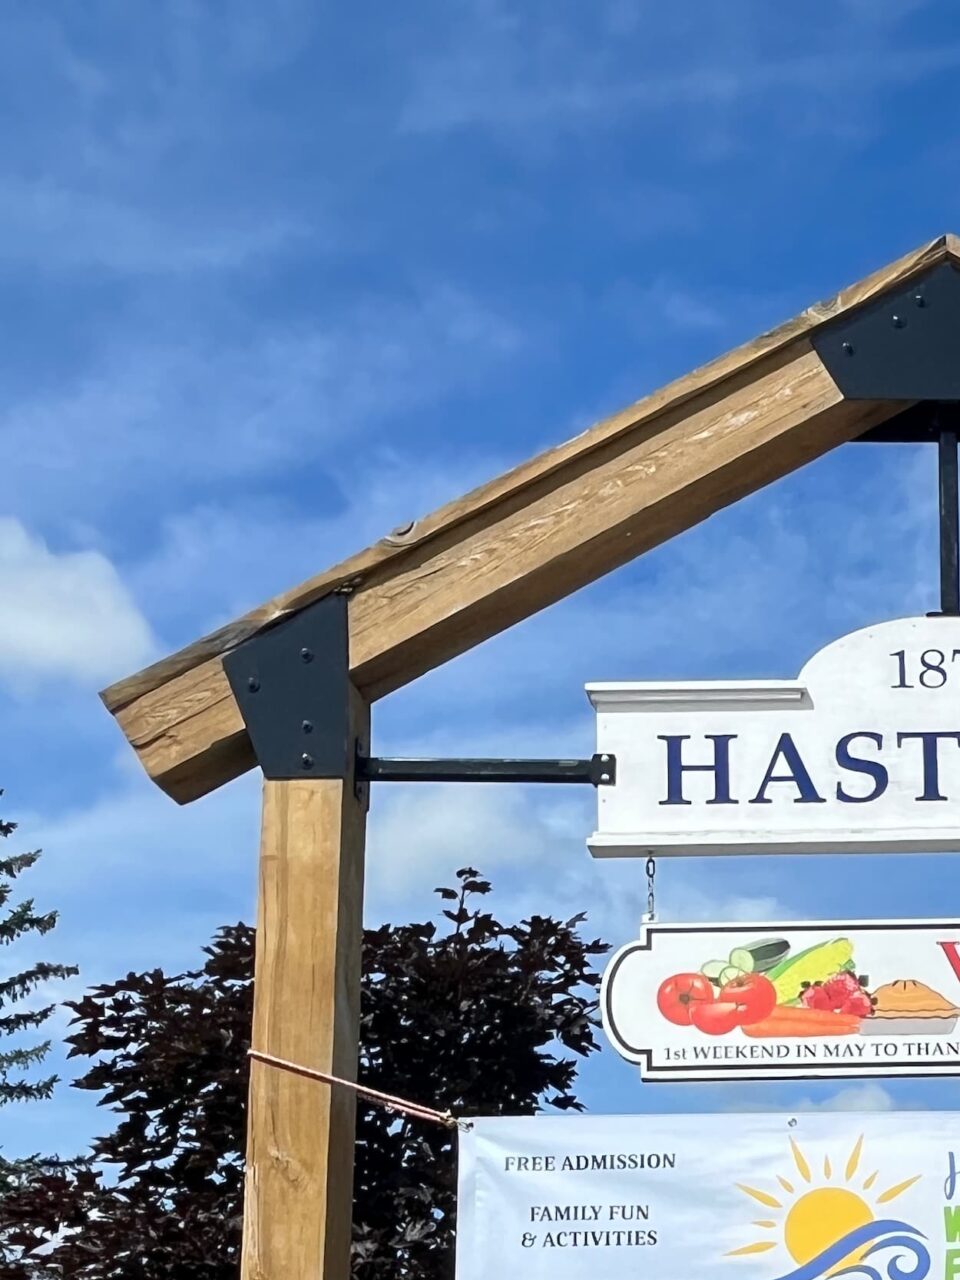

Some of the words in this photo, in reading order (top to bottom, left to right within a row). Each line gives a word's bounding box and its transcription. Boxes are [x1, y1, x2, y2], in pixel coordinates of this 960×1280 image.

[664, 1047, 687, 1060] 1st
[693, 1045, 790, 1060] WEEKEND
[796, 1045, 817, 1058] IN
[823, 1044, 867, 1058] MAY
[870, 1043, 898, 1057] TO
[505, 1156, 556, 1171] FREE
[561, 1153, 676, 1171] ADMISSION
[530, 1206, 603, 1222] FAMILY
[609, 1205, 649, 1221] FUN
[521, 1233, 537, 1247] &
[542, 1230, 658, 1248] ACTIVITIES
